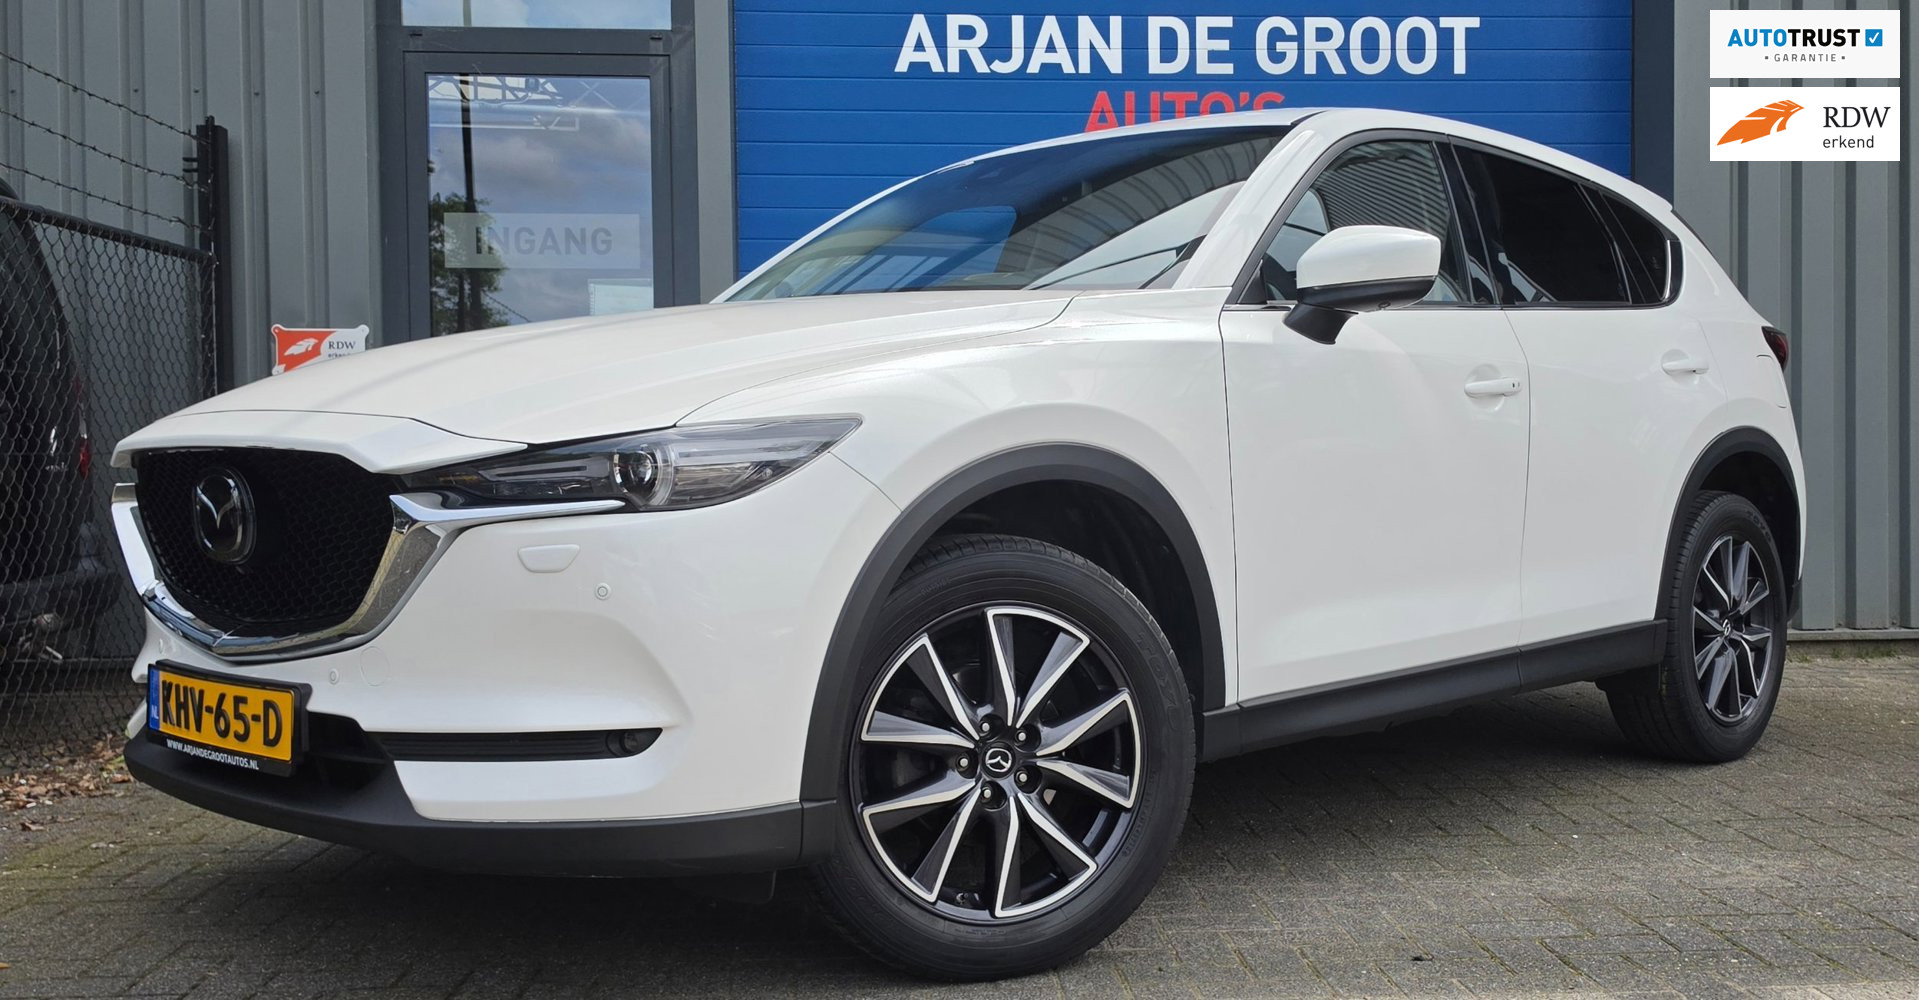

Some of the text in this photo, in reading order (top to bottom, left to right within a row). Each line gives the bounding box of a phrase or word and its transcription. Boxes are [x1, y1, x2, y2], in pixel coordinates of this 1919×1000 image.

[894, 13, 1481, 75] ARJAN DE GROOT
[475, 226, 614, 256] INGANG
[328, 341, 356, 350] RDW
[150, 705, 160, 720] NL
[161, 679, 283, 748] KHV-65-D
[166, 738, 260, 770] WWW.ARJANDEGROOTAUTOS.NL
